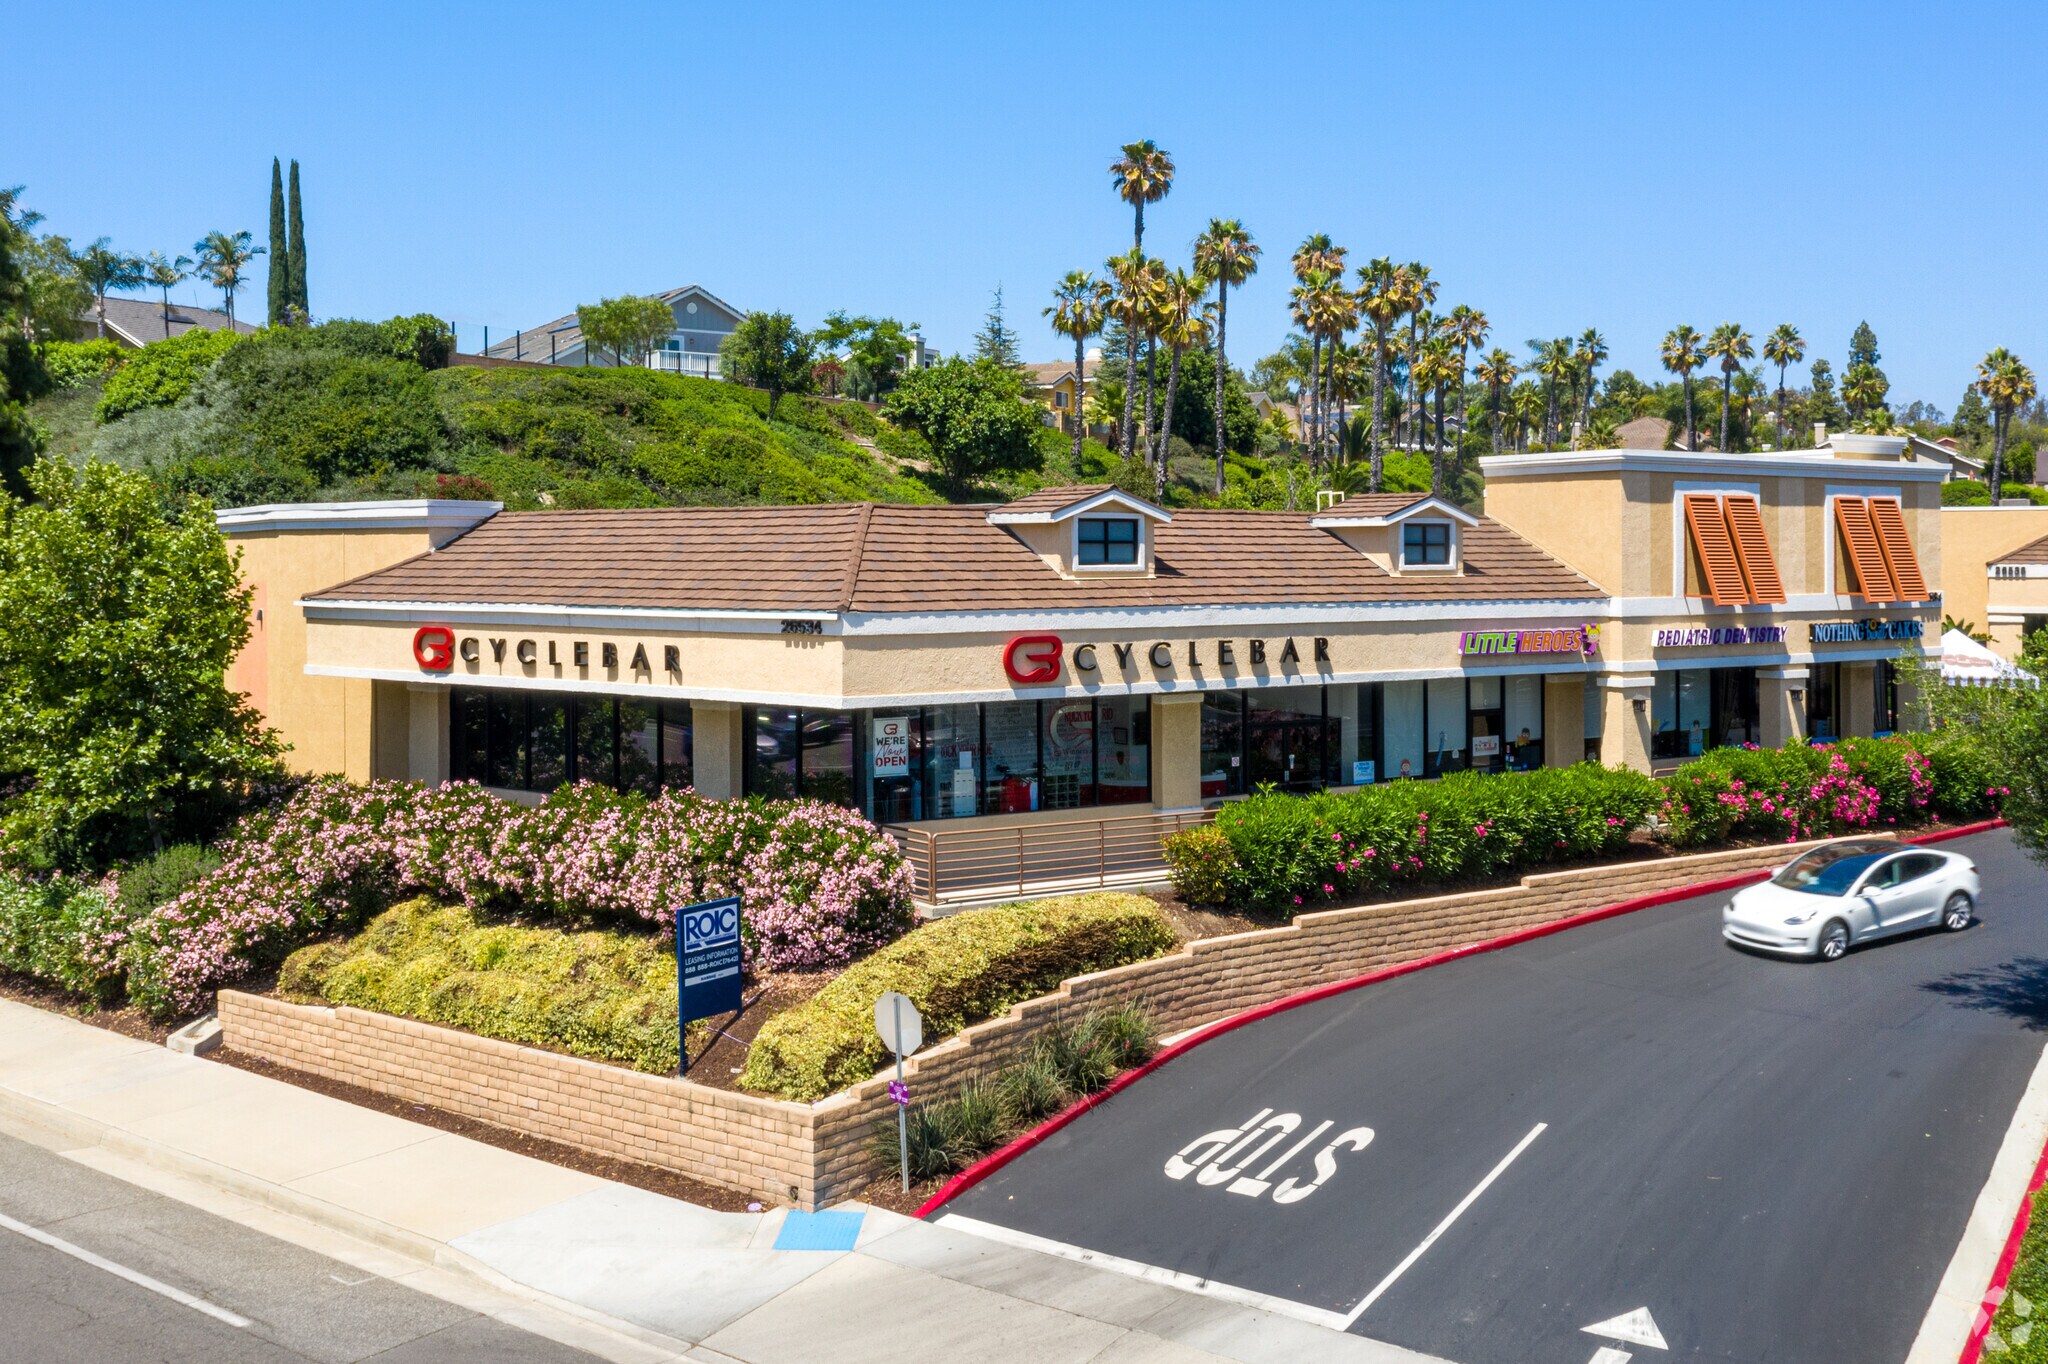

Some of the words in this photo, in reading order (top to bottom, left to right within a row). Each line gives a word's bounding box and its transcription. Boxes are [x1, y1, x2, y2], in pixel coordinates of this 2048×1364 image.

[1465, 632, 1518, 654] LITTLE
[1520, 630, 1582, 652] HEROES
[1657, 628, 1720, 647] PEDIATRIC
[1724, 626, 1788, 645] DENTISTRY
[1814, 623, 1865, 643] NOTHING
[1888, 620, 1925, 640] CAKES
[460, 637, 680, 672] CYCLEBAR
[1073, 636, 1330, 672] CYCLEBAR
[876, 736, 905, 746] WE'RE
[875, 756, 906, 767] OPEN
[685, 908, 736, 942] ROIC
[685, 954, 706, 966] LEASING
[706, 946, 738, 960] INFORMATION
[685, 966, 696, 974] 888
[1164, 1107, 1376, 1204] STOP
